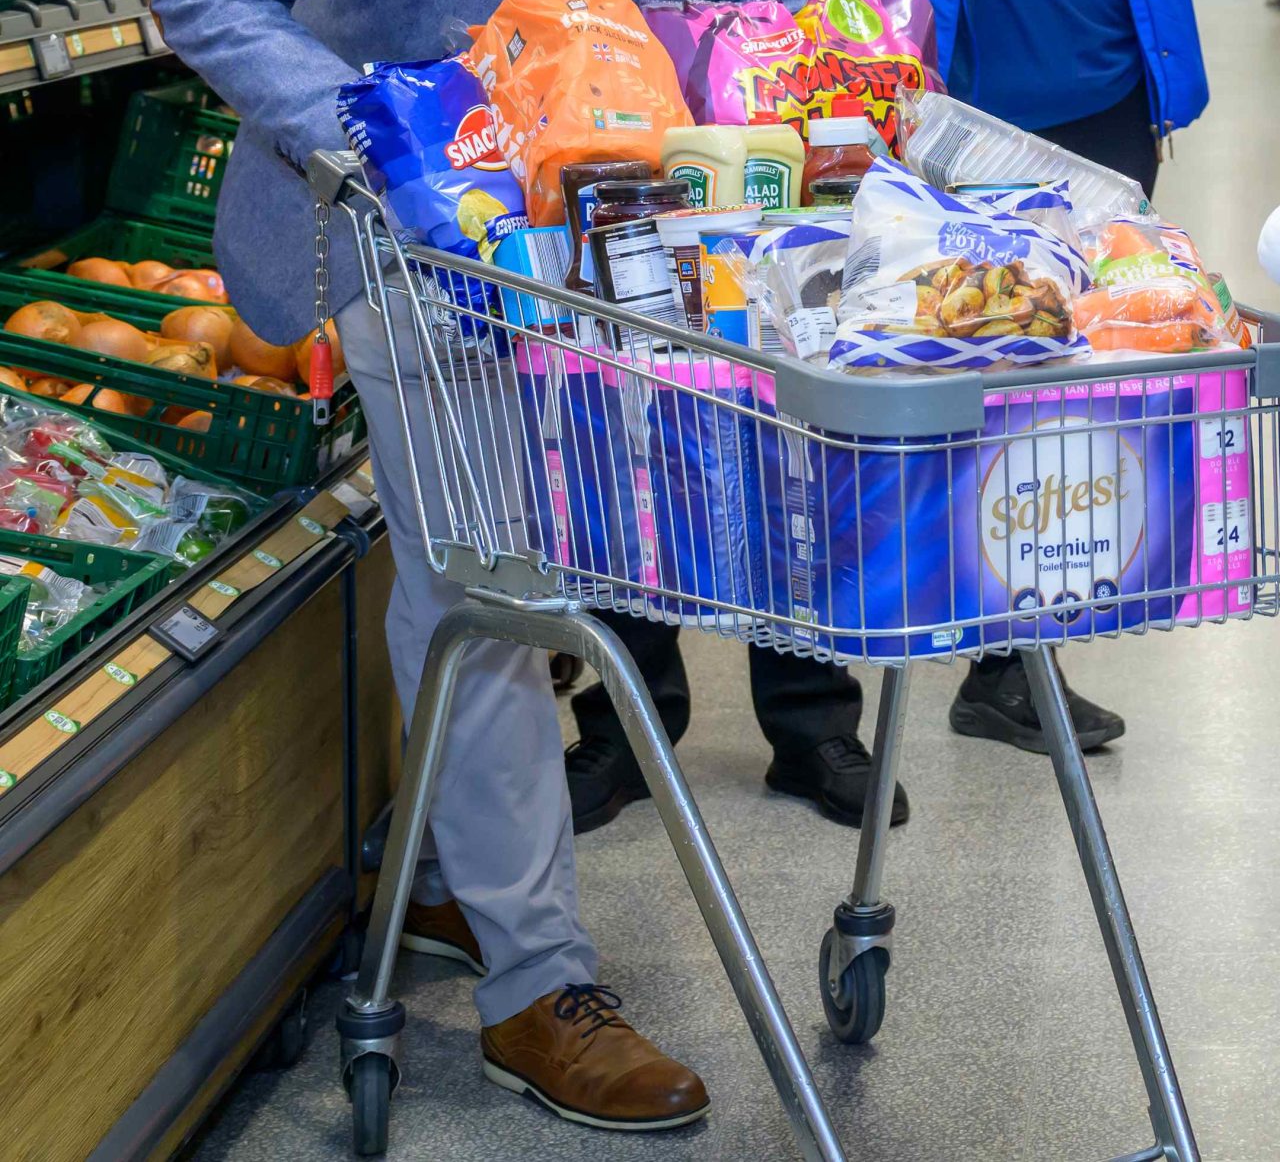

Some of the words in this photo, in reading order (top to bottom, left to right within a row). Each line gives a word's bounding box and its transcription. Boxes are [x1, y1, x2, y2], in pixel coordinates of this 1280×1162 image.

[745, 184, 779, 197] ALAD
[495, 216, 530, 236] CHEES
[1155, 375, 1186, 387] ROLL
[1216, 429, 1235, 448] 12
[1210, 457, 1240, 468] DOBLE
[1214, 464, 1238, 474] RLLS
[990, 456, 1129, 542] Softest
[1217, 525, 1240, 546] 24
[1038, 562, 1063, 572] Toilet
[1065, 560, 1090, 570] Tissu
[1207, 553, 1247, 566] STADARD
[1216, 561, 1241, 571] RLLS
